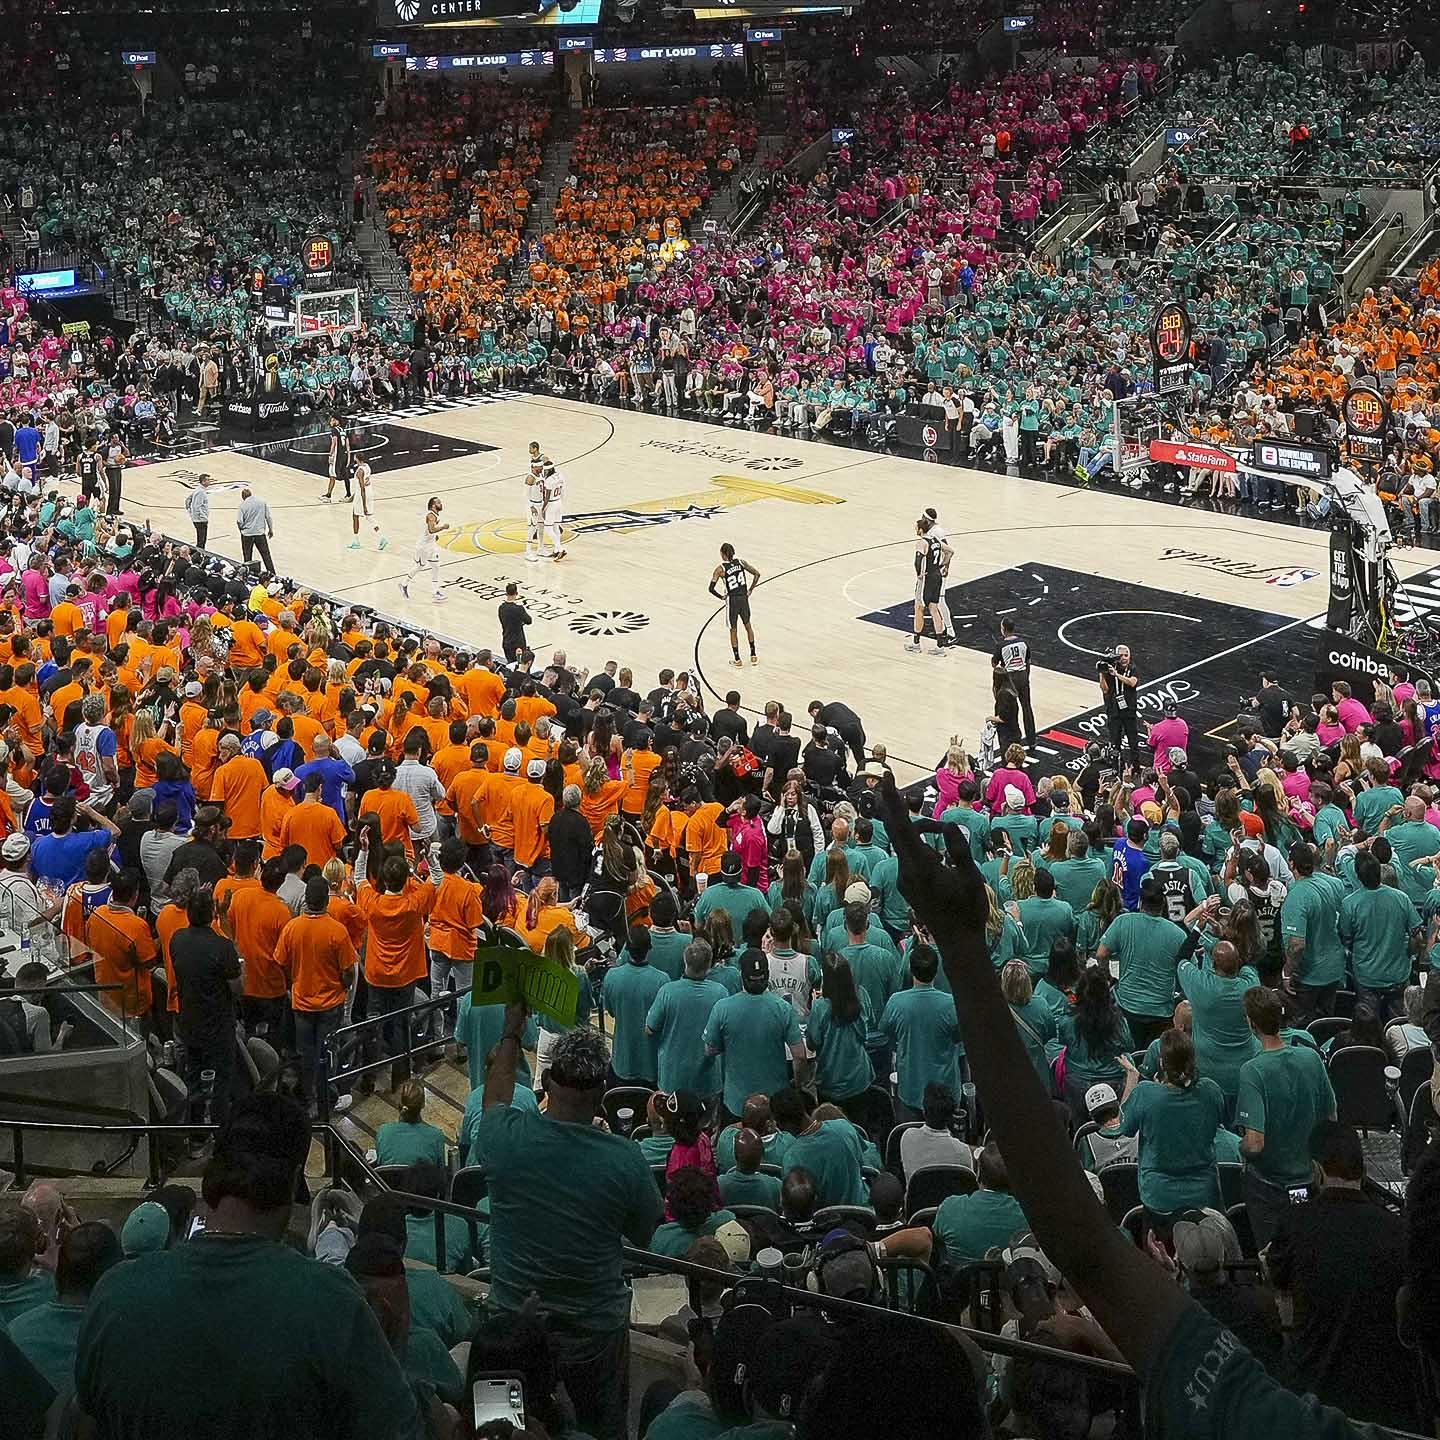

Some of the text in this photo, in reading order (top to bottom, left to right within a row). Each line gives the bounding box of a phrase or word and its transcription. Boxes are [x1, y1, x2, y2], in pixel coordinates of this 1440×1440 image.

[477, 56, 507, 65] LOUD
[665, 48, 697, 57] LOUD
[311, 242, 328, 252] 8:03
[310, 251, 327, 267] 24
[1162, 314, 1180, 330] 8:03
[1160, 328, 1183, 356] 24
[1334, 561, 1346, 575] THE
[727, 571, 745, 590] 24
[440, 576, 576, 621] Frost Bank
[1329, 650, 1389, 678] coinba
[1166, 895, 1185, 921] 5
